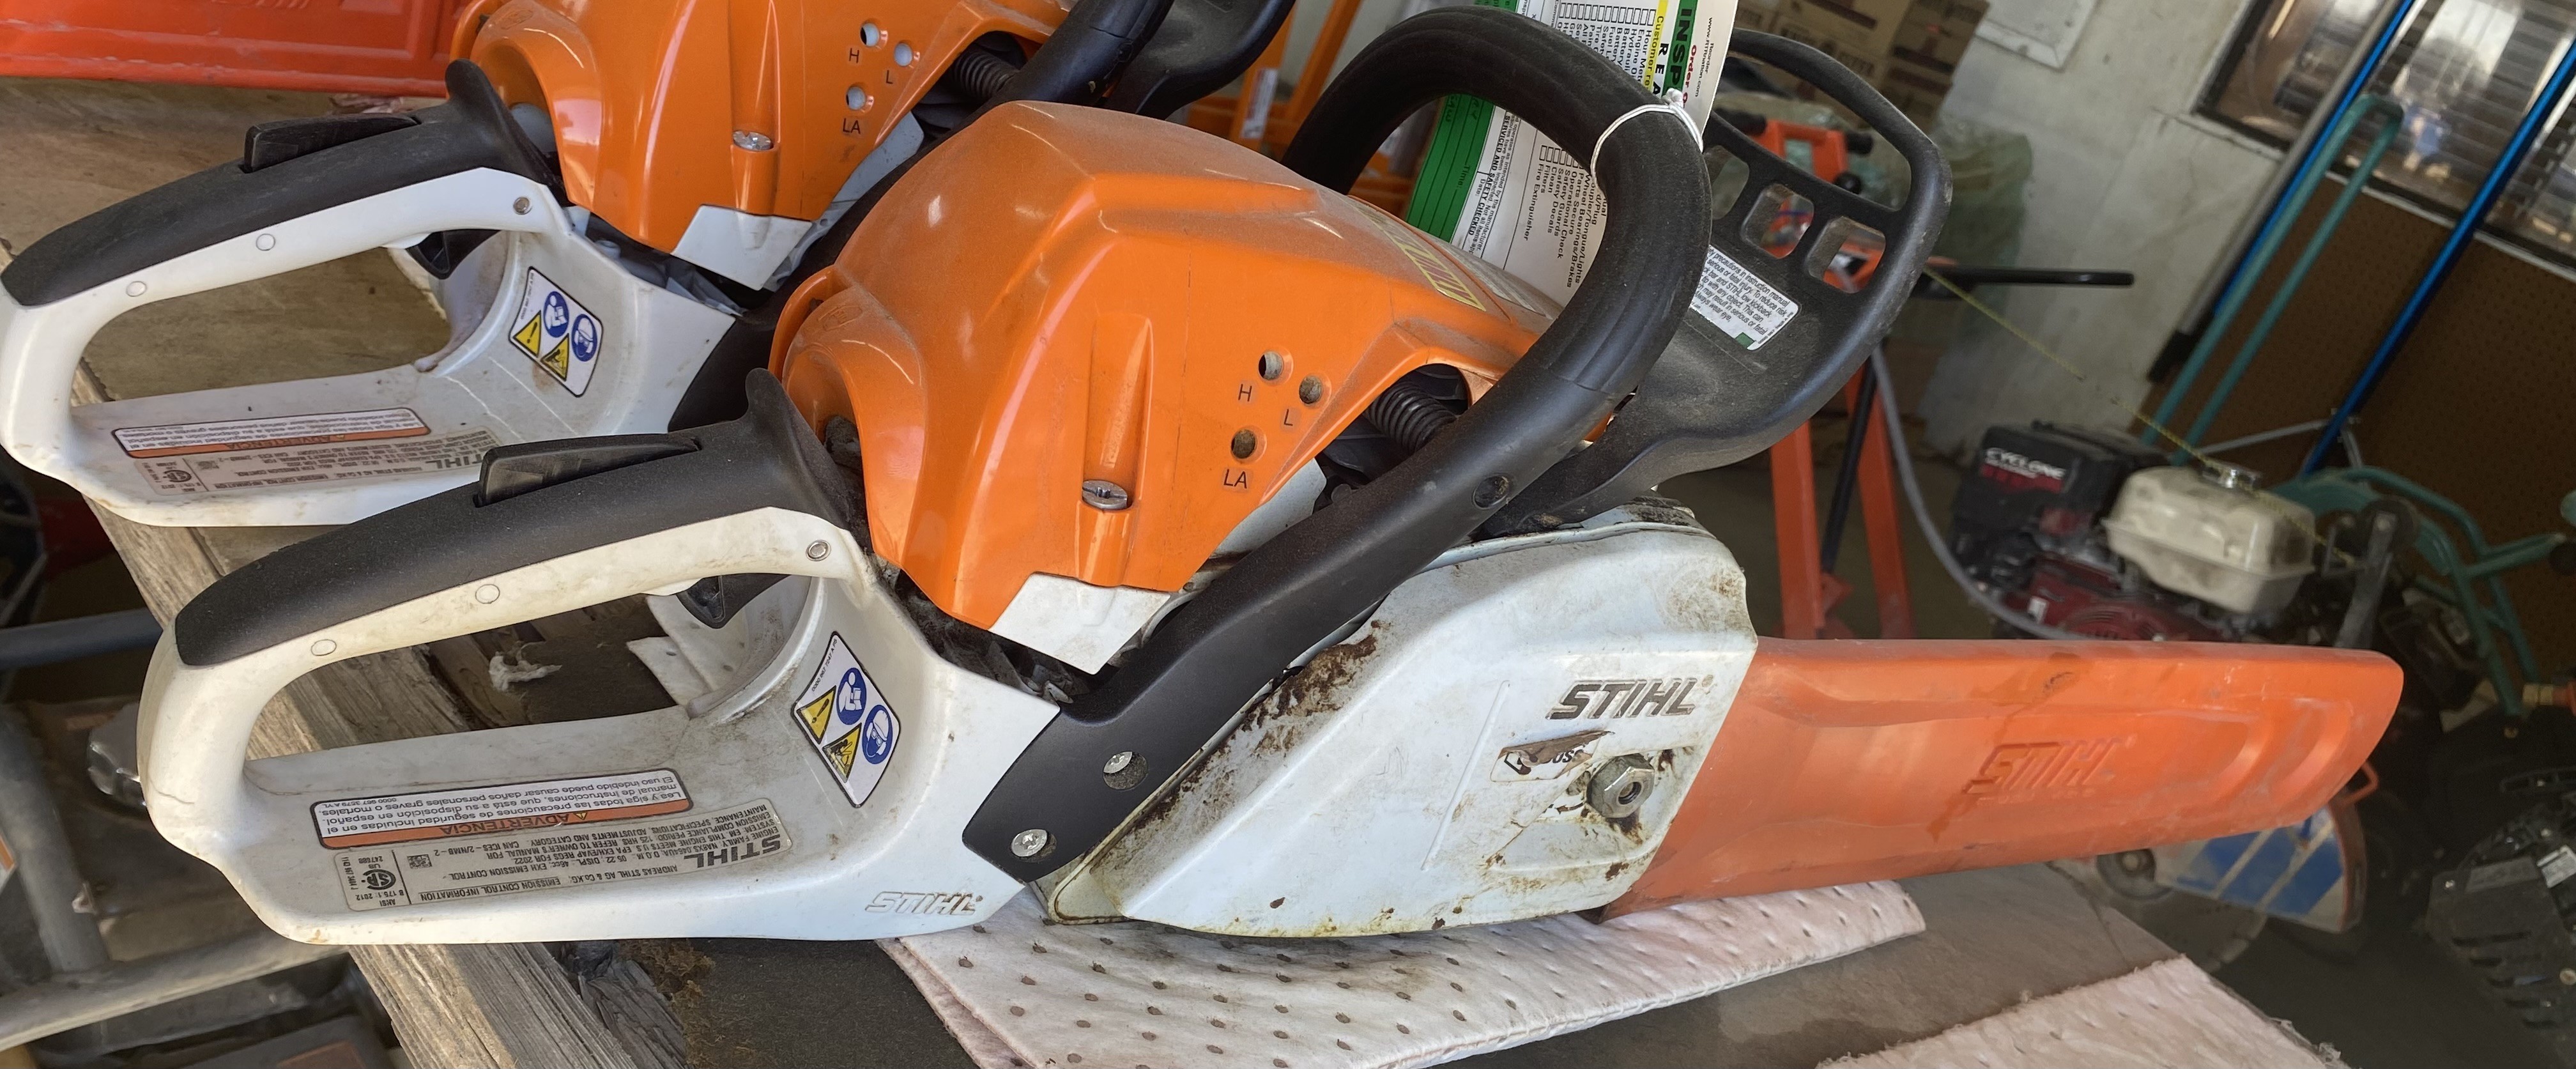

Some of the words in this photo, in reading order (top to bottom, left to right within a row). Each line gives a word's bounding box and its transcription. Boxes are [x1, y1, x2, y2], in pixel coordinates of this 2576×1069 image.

[1607, 26, 1615, 47] Fuel
[1641, 29, 1651, 55] Hour
[1646, 16, 1664, 72] Customer
[1624, 28, 1637, 71] Hydrauli
[1632, 29, 1644, 63] Engine
[1668, 8, 1691, 86] INSP
[849, 48, 859, 63] H
[1652, 42, 1668, 95] REA
[1684, 45, 1697, 88] Order
[885, 70, 893, 84] L
[843, 118, 861, 134] LA
[1496, 115, 1510, 152] SERVICED
[1491, 155, 1500, 171] AND
[1457, 164, 1471, 189] Time:
[1498, 162, 1509, 188] intended
[1536, 164, 1544, 181] Fire
[1540, 165, 1551, 194] Filters
[1547, 166, 1558, 193] Clean
[1475, 178, 1485, 197] Date:
[1481, 173, 1495, 201] SAFETY
[1552, 167, 1565, 198] Safety
[1560, 169, 1572, 200] Safety
[1575, 173, 1584, 197] Parts
[1581, 174, 1592, 206] Wheel
[1494, 190, 1501, 198] by
[1562, 171, 1577, 227] Operational
[1468, 202, 1485, 236] CHECKED
[1522, 183, 1541, 241] Extinguisher
[1547, 201, 1559, 233] Decals
[1554, 202, 1565, 236] Guards
[1568, 201, 1579, 235] Secure
[1473, 225, 1483, 242] items
[1557, 229, 1568, 259] Check
[1565, 208, 1585, 288] Bearings/Brakes
[1712, 253, 1741, 274] precautions
[1745, 274, 1770, 293] instruction
[1768, 291, 1790, 307] manual
[1706, 259, 1724, 273] serious
[1729, 273, 1742, 284] fatal
[1758, 295, 1777, 310] reduce
[1775, 307, 1788, 317] risk
[1708, 270, 1718, 279] bar
[1716, 276, 1728, 286] and
[1726, 282, 1743, 296] STIHL
[1740, 293, 1752, 303] low
[1749, 299, 1773, 318] kickback
[1707, 281, 1719, 290] with
[1716, 289, 1726, 297] any
[1725, 294, 1744, 309] object.
[1742, 305, 1755, 316] This
[1752, 314, 1763, 323] can
[1709, 303, 1722, 313] wear
[1701, 289, 1713, 298] may
[1712, 294, 1728, 307] result
[1730, 308, 1749, 323] serious
[1753, 324, 1767, 335] fatal
[1238, 384, 1252, 401] H
[1284, 409, 1293, 426] L
[225, 435, 330, 450] ADVERTENCIA
[425, 454, 483, 470] TIHL
[1223, 469, 1247, 489] LA
[1545, 677, 1697, 719] STIHL
[1961, 737, 2121, 794] STIHL
[524, 788, 558, 796] causar
[562, 784, 593, 794] puede
[596, 780, 638, 791] indebido
[638, 783, 677, 795] manual
[425, 794, 485, 808] personales
[487, 791, 521, 801] daños
[520, 797, 540, 805] que
[544, 790, 618, 803] instrucciones,
[595, 797, 624, 808] todas
[626, 794, 648, 804] siga
[660, 791, 680, 800] Lea
[318, 805, 371, 817] mortales.
[385, 800, 422, 810] graves
[397, 804, 461, 819] disposición
[493, 800, 516, 809] está
[496, 803, 571, 817] precauciones
[574, 801, 591, 810] las
[322, 813, 374, 826] español.
[418, 811, 475, 826] seguridad
[479, 811, 493, 819] de
[735, 811, 769, 827] EMISSION
[361, 819, 413, 831] incluidas
[439, 813, 569, 835] ADVERTENCIA
[686, 822, 733, 837] COMPLIANCE
[592, 828, 646, 840] ADJUSTMENTS
[707, 833, 724, 842] THIS
[750, 826, 778, 839] ENGINE
[502, 841, 519, 849] CAN
[542, 843, 577, 852] OWNER'S
[592, 839, 616, 848] REFER
[650, 841, 675, 850] MEETS
[679, 836, 704, 847] ENGINE
[486, 851, 503, 859] FOR
[505, 847, 539, 858] MANUAL
[553, 852, 573, 860] REGS
[683, 834, 783, 870] STIHL
[489, 865, 528, 875] EMISSION
[530, 863, 546, 871] EXH
[617, 869, 640, 878] STIHL
[641, 865, 677, 875] ANDREAS
[448, 869, 487, 881] CONTROL
[480, 882, 519, 894] CONTROL
[521, 877, 560, 889] EMISSION
[420, 887, 479, 900] INFORMATION
[865, 891, 976, 915] STIHL
